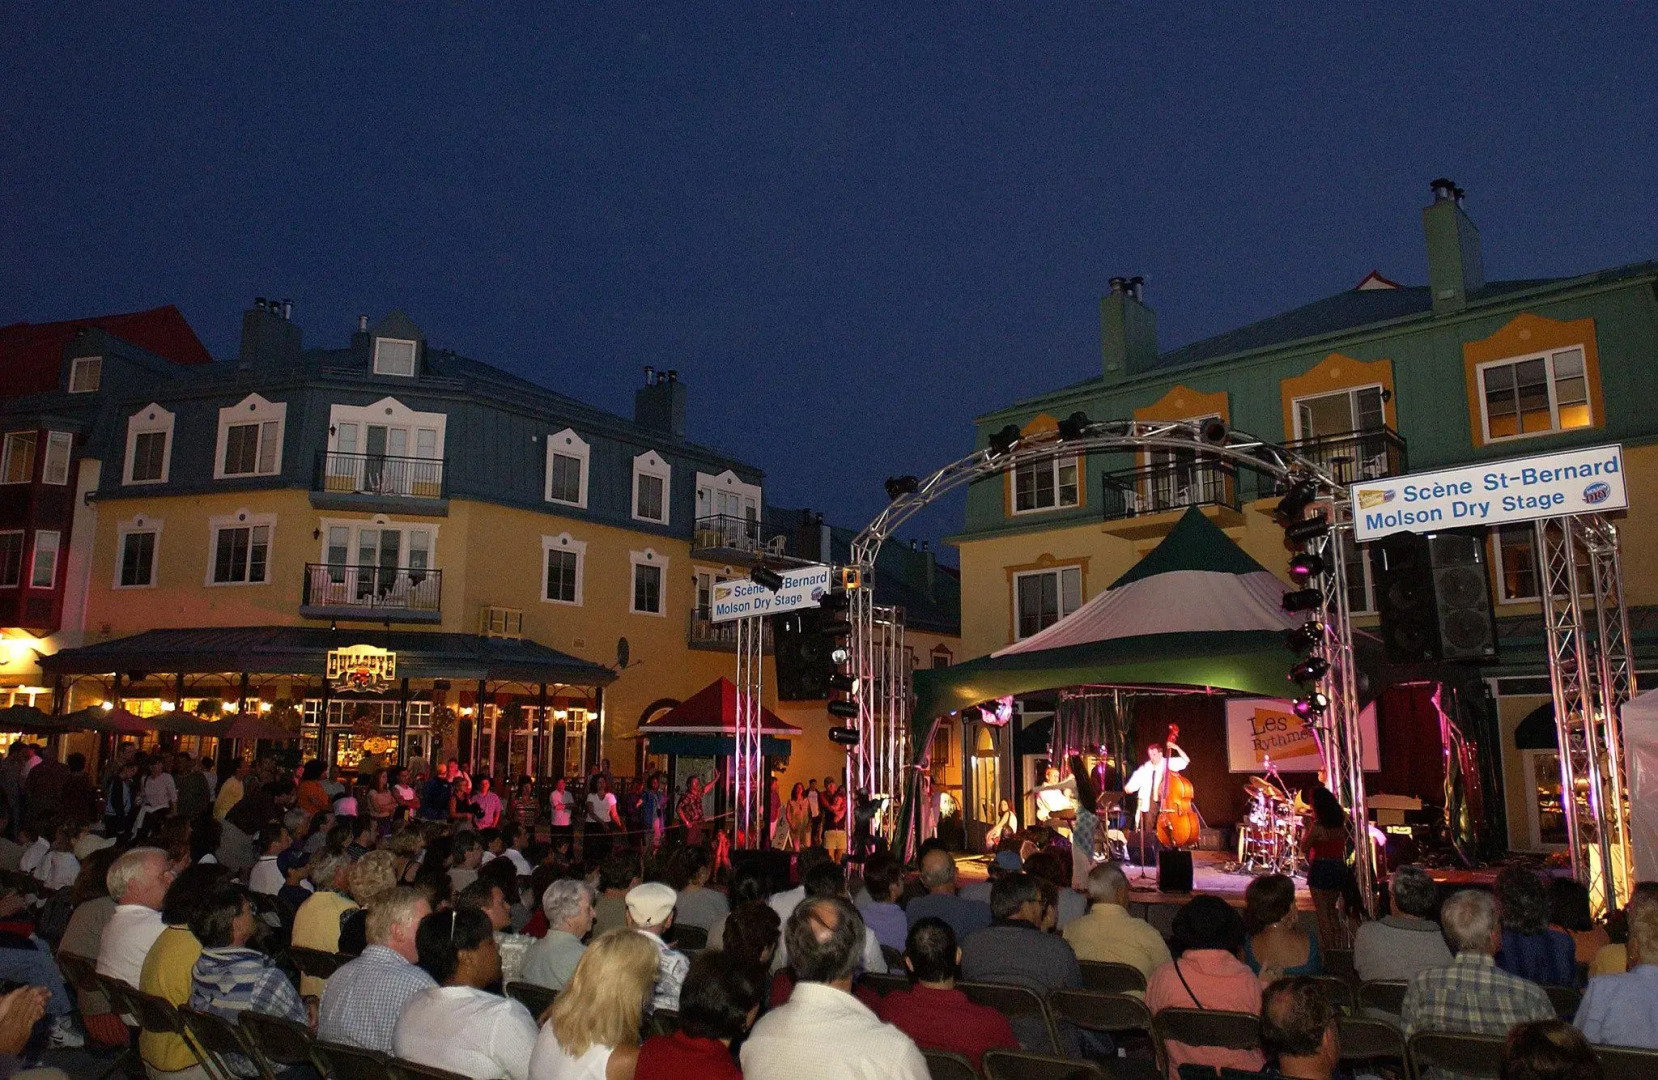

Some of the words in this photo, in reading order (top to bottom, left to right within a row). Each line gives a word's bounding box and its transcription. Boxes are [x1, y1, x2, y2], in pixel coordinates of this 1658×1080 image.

[1403, 481, 1472, 503] Scène
[1483, 456, 1618, 491] St-Bernard
[1582, 489, 1607, 504] DRY
[1366, 508, 1443, 531] Molson
[1453, 501, 1490, 518] Dry
[1502, 492, 1565, 512] Stage
[734, 584, 765, 597] Scène
[782, 570, 827, 589] -Bernard
[716, 601, 750, 616] Molson
[754, 599, 771, 610] Dry
[775, 593, 803, 606] Stage
[1247, 716, 1287, 736] Les
